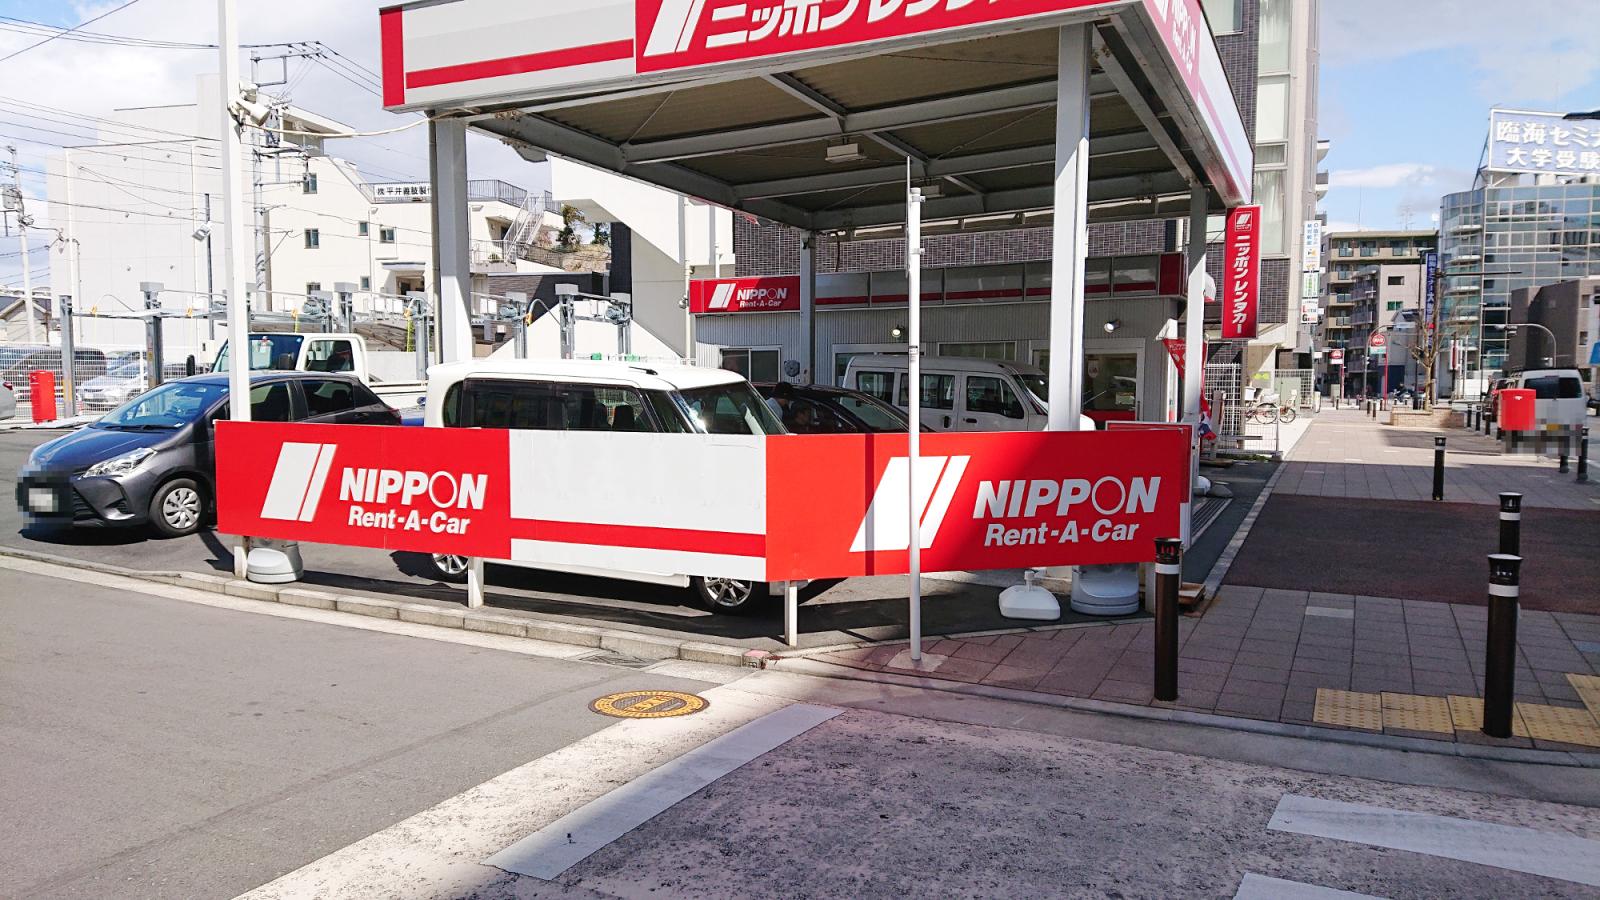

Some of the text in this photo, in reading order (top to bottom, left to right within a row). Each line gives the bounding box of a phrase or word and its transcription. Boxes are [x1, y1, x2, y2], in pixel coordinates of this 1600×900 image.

[736, 287, 787, 301] NIPPON
[1232, 234, 1251, 334] ニッポンレンタカー
[740, 300, 781, 308] Rent-A-Car
[340, 468, 488, 509] NIPPON
[972, 475, 1162, 519] NIPPON
[348, 505, 470, 534] Rent-A-Car
[984, 519, 1139, 547] Rent-A-Car
